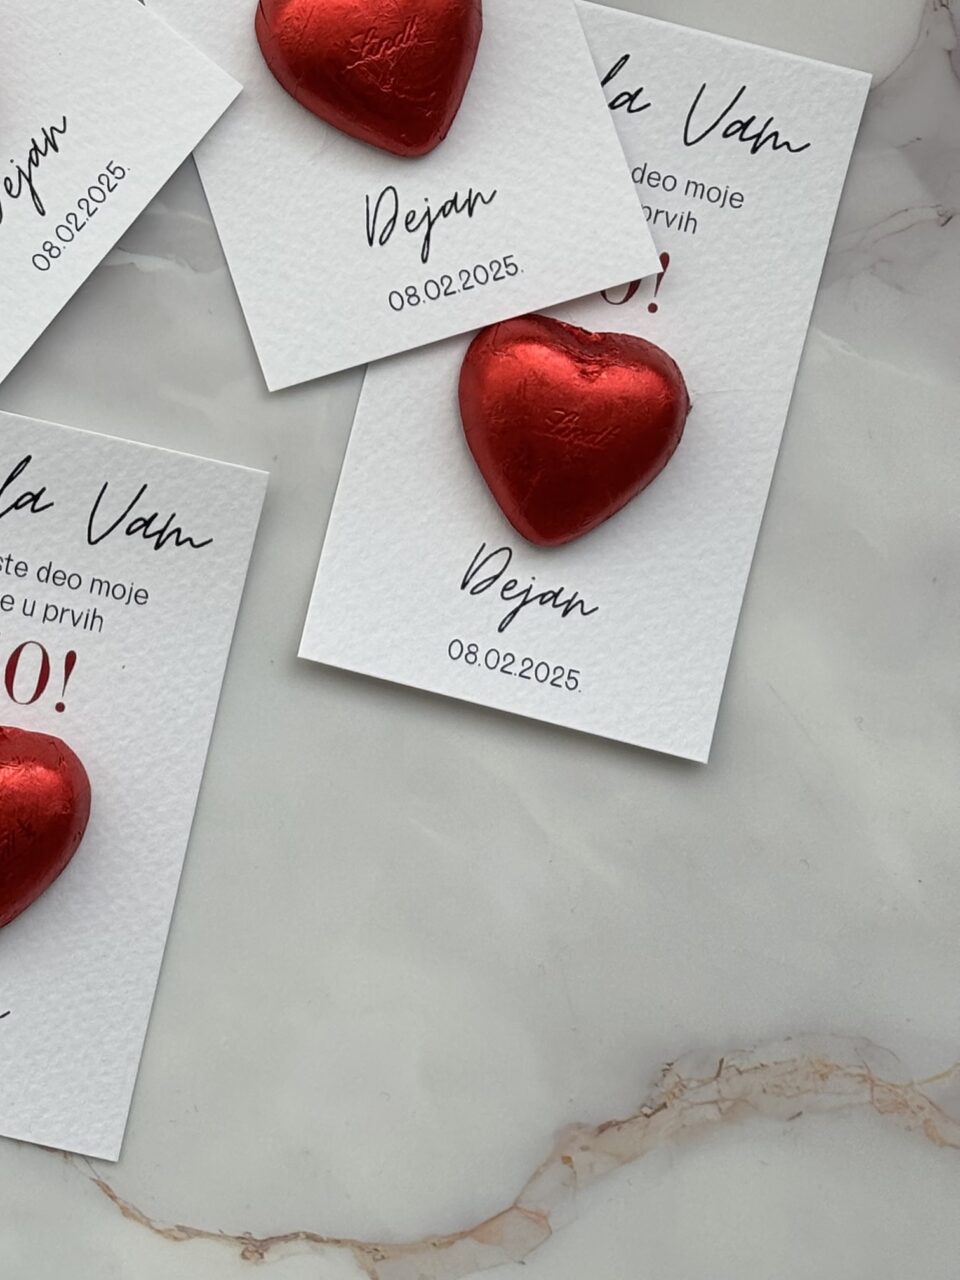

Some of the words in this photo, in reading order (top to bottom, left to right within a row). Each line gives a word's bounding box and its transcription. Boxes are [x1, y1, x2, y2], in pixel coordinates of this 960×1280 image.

[683, 83, 811, 155] Vam
[32, 160, 131, 271] 08.02.2025.
[631, 162, 677, 192] deo
[684, 180, 744, 209] moje
[366, 185, 497, 264] Dejan
[388, 255, 524, 312] 08.02.2025.
[87, 481, 213, 551] Vam
[37, 561, 82, 590] deo
[89, 577, 149, 605] moje
[460, 542, 599, 634] Dejan
[22, 598, 36, 618] u
[42, 603, 103, 632] prvih
[448, 639, 581, 693] 08.02.2025.
